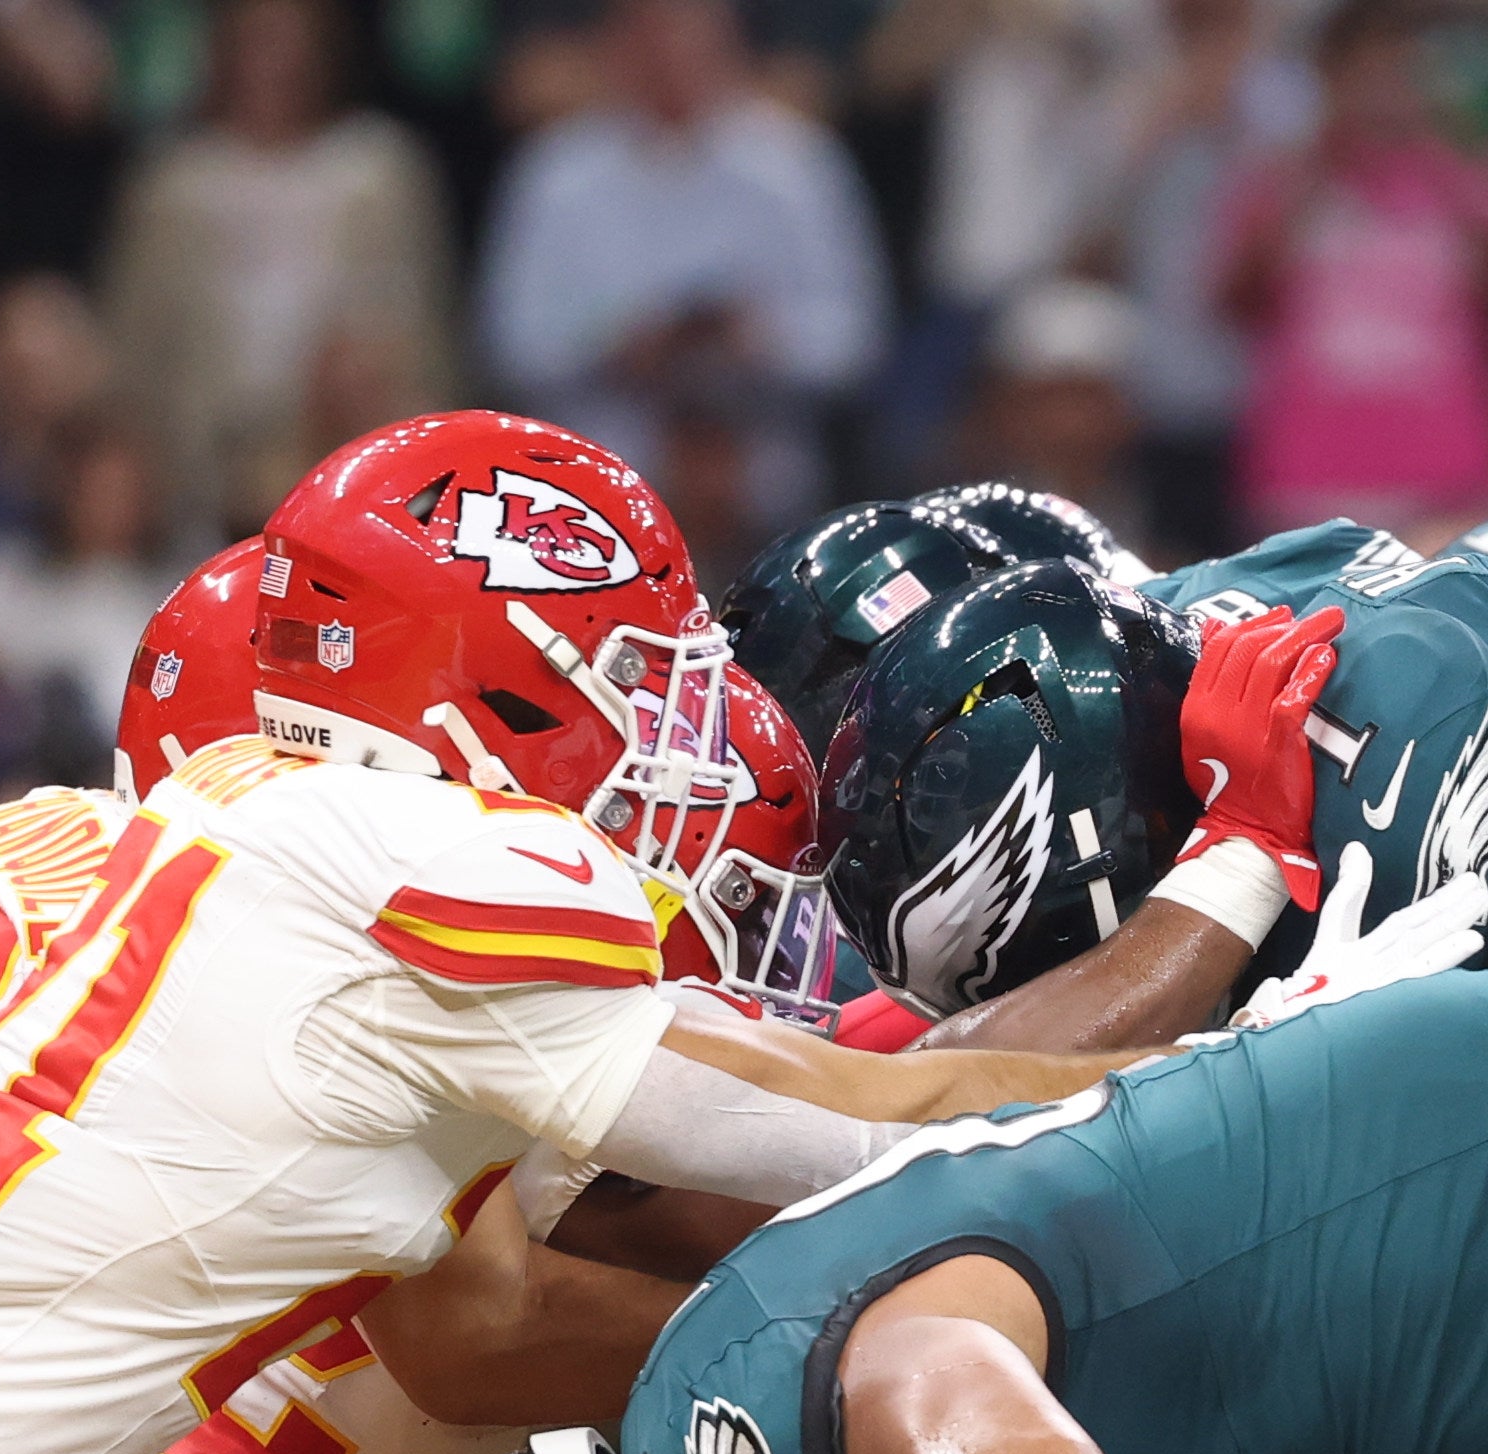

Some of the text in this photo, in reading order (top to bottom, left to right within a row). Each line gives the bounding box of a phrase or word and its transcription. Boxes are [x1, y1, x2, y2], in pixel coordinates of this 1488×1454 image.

[496, 492, 616, 582] KC
[322, 643, 348, 664] NFL
[154, 671, 172, 692] NFL
[281, 720, 332, 748] LOVE
